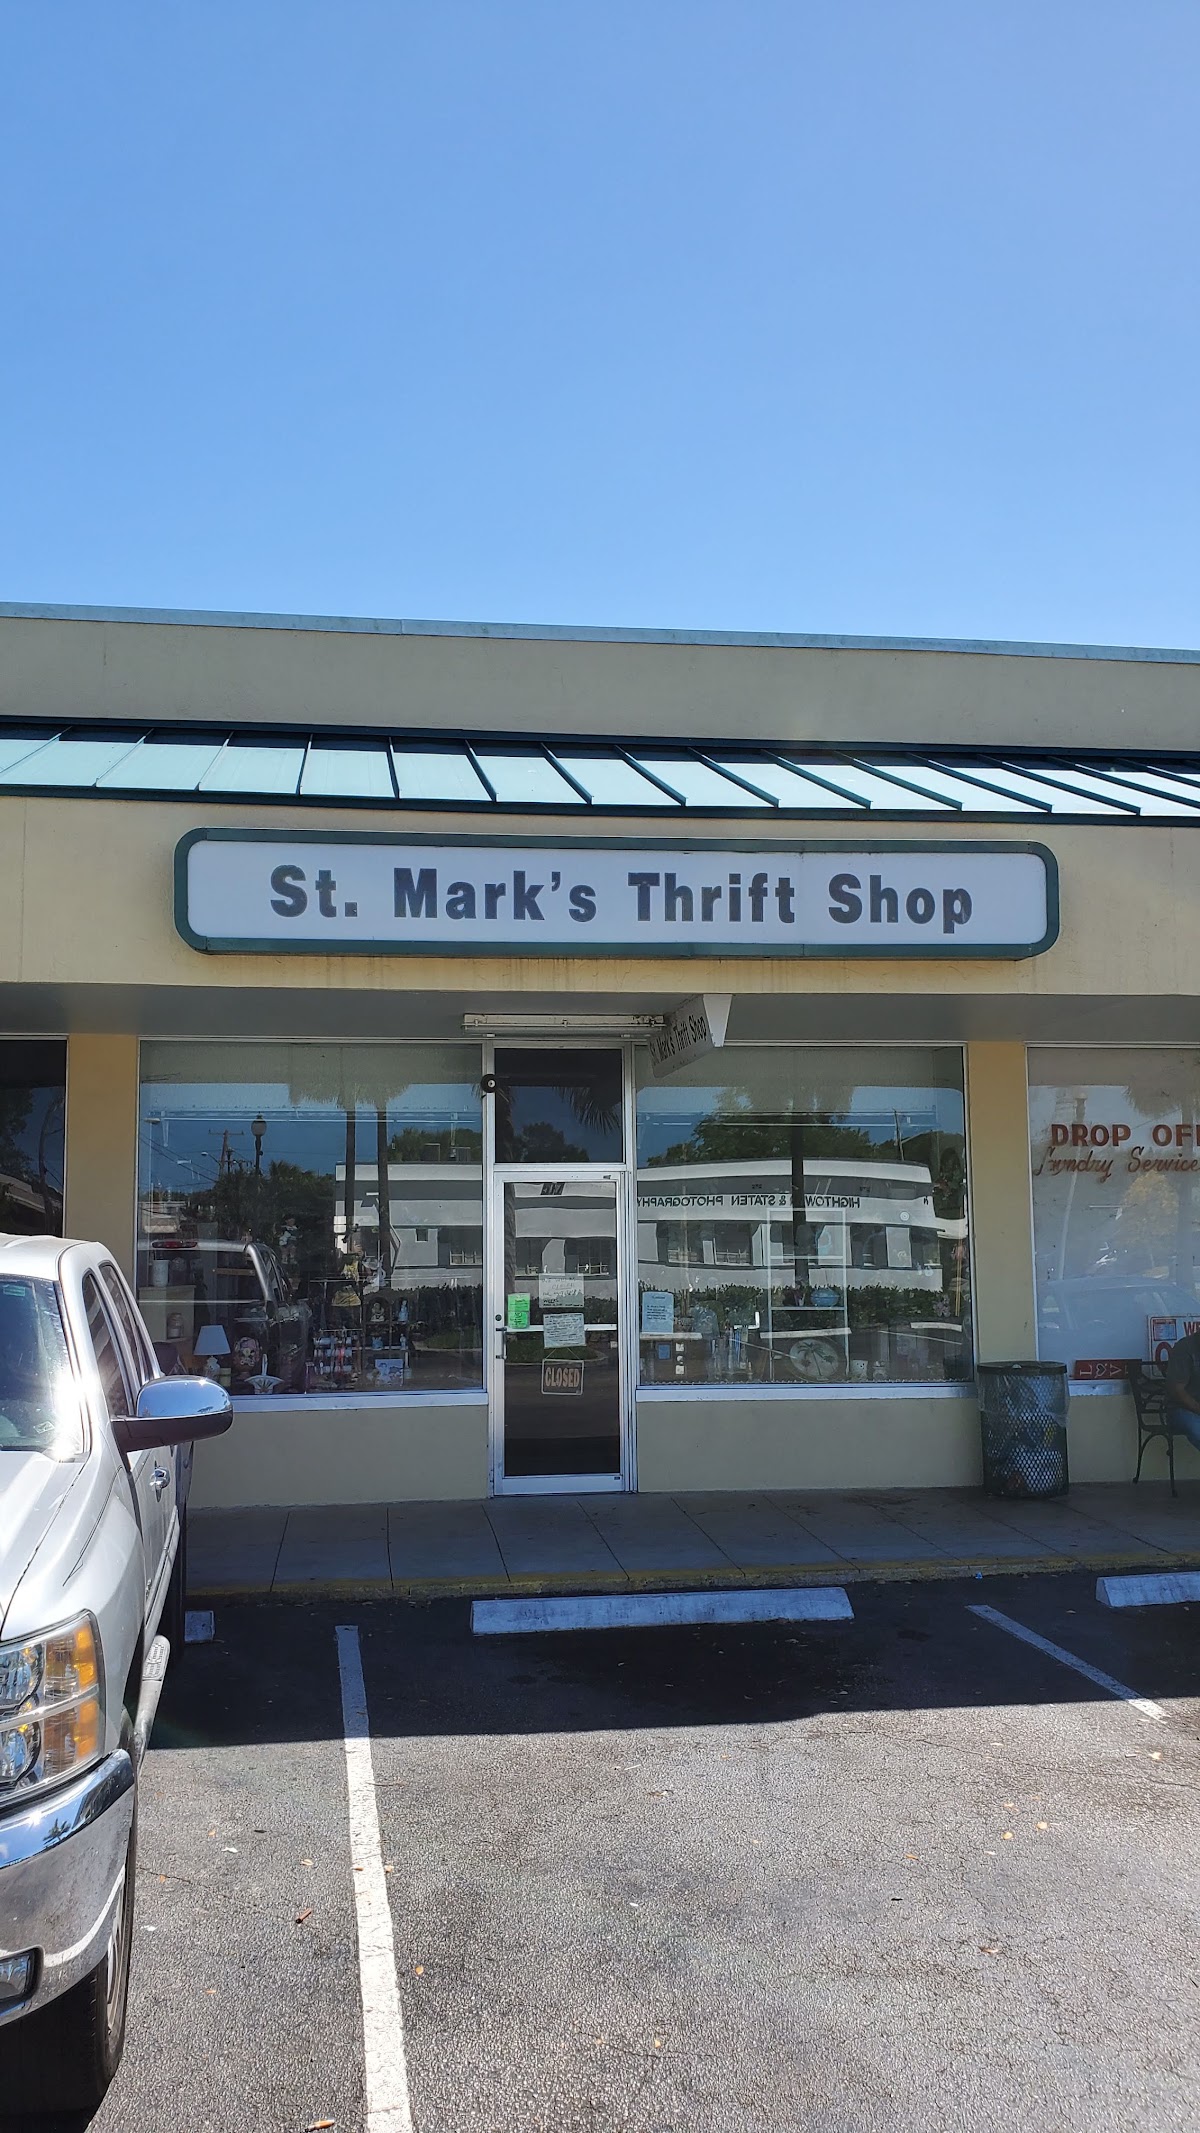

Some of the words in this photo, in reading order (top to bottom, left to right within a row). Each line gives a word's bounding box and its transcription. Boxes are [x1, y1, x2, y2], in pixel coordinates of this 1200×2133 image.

[270, 864, 358, 918] St.
[394, 867, 597, 923] Mark's
[628, 872, 796, 924] Thrift
[828, 873, 973, 934] Shop
[673, 1021, 692, 1051] Thrift
[688, 1015, 707, 1043] Shop
[1051, 1123, 1131, 1147] DROP
[545, 1367, 580, 1387] CLOSED
